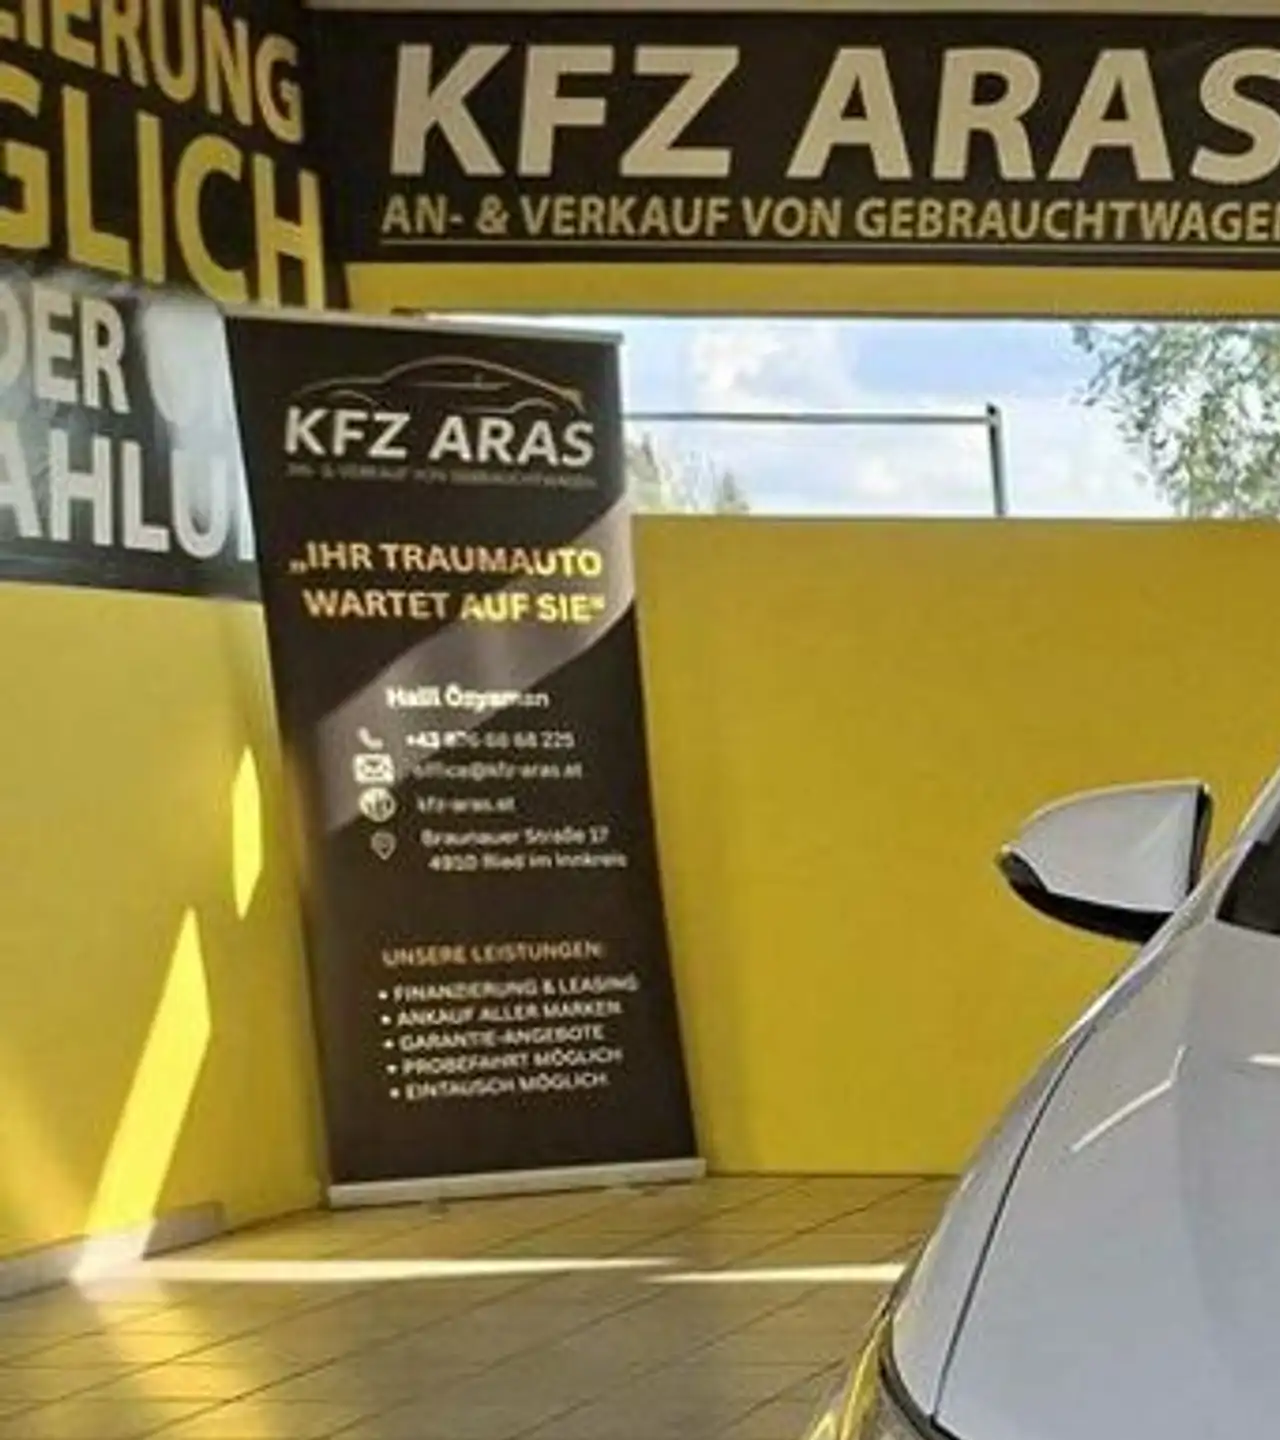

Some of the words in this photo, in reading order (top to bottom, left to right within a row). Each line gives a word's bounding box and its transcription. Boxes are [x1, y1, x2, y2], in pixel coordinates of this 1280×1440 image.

[0, 0, 304, 144] ERUNG
[390, 43, 741, 178] KFZ
[381, 194, 465, 236] AN-
[476, 195, 508, 236] &
[519, 196, 731, 238] VERKAUF
[741, 197, 842, 239] VON
[284, 405, 412, 460] KFZ
[428, 415, 596, 468] ARAS
[380, 543, 603, 578] TRAUMAUTO
[302, 588, 450, 619] WARTET
[461, 592, 530, 622] AUF
[382, 947, 466, 968] UNSERE
[394, 979, 538, 1003] FINANZIERUNG
[559, 972, 639, 996] LEASING
[397, 1006, 474, 1027] ANKAUF
[479, 1003, 538, 1023] ALLER
[543, 1000, 623, 1019] MARKEN
[402, 1052, 528, 1076] PROBEFAHRT
[533, 1046, 623, 1068] MÖGLICH
[405, 1076, 514, 1100] EINTAUSCH
[519, 1071, 608, 1093] MÖGLICH
